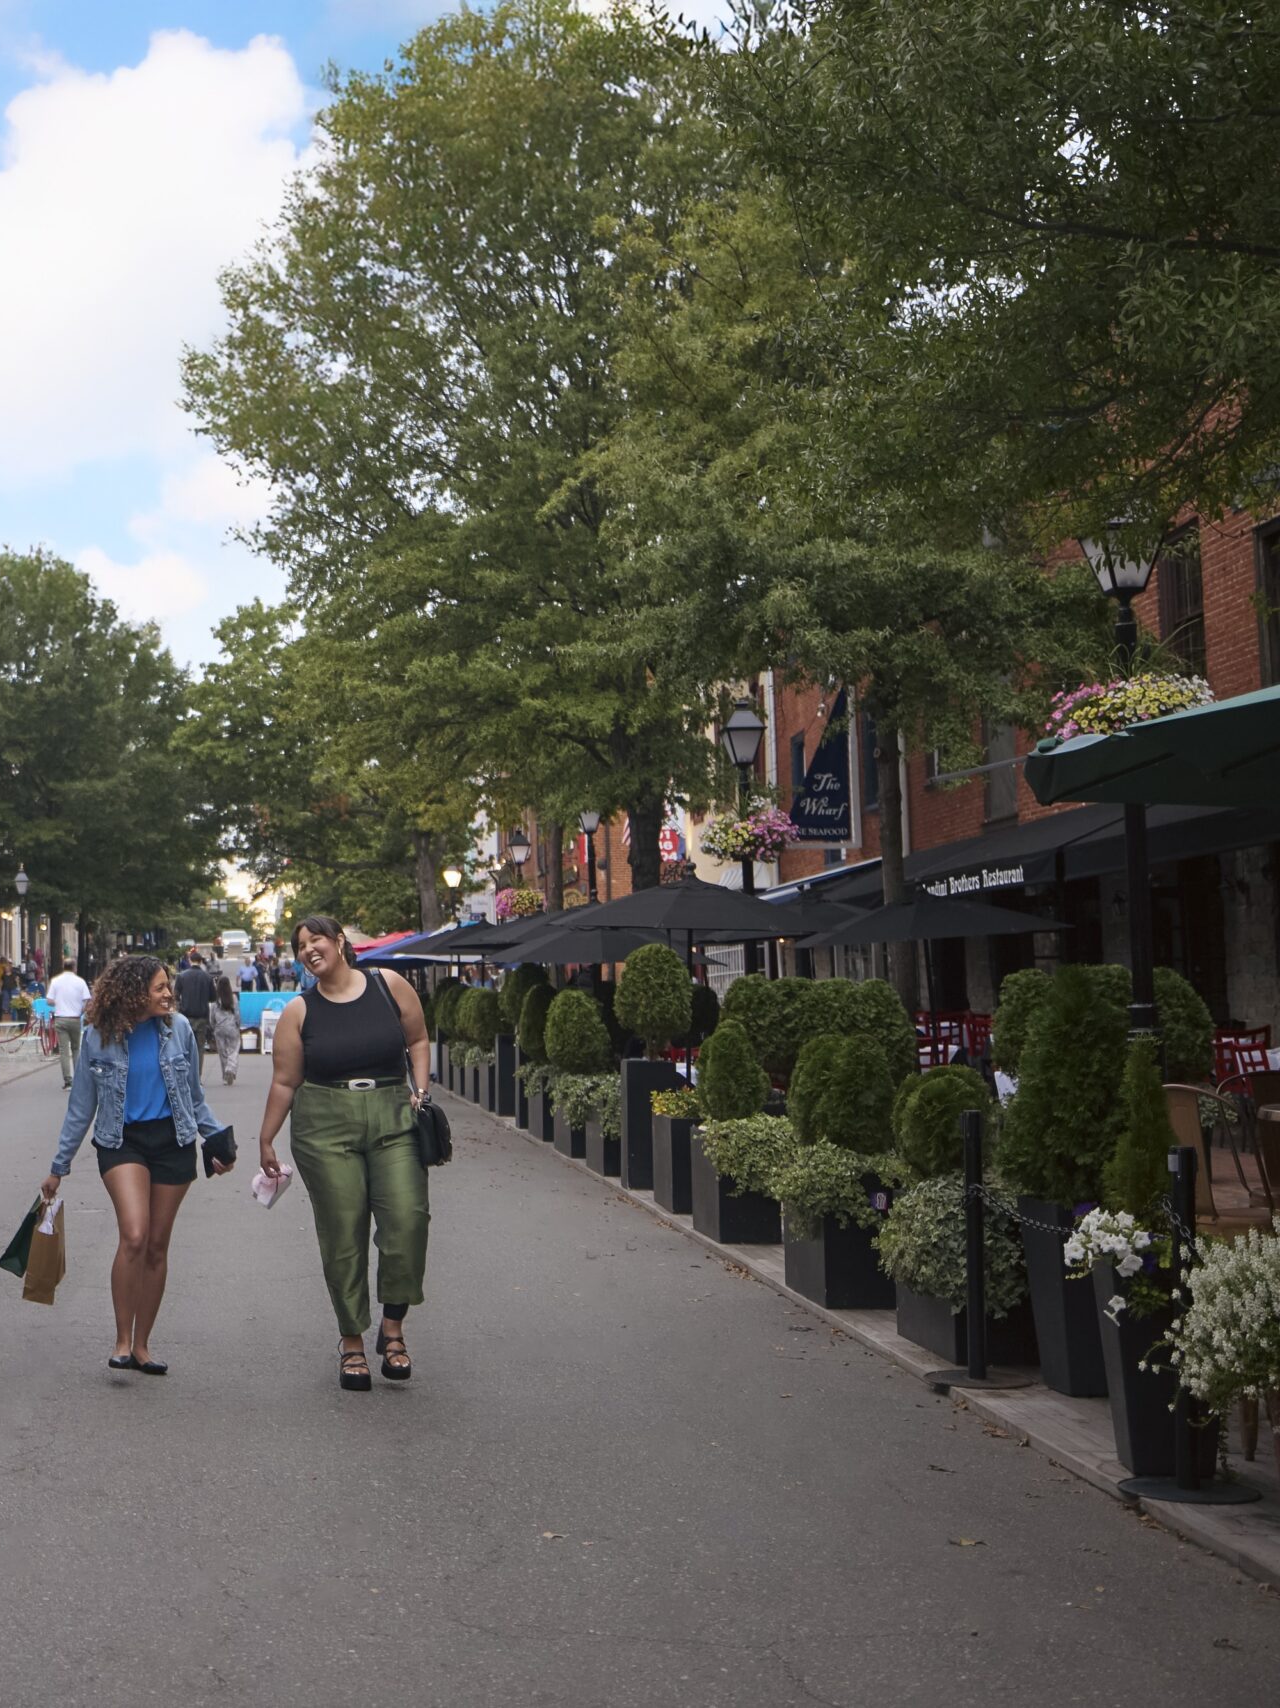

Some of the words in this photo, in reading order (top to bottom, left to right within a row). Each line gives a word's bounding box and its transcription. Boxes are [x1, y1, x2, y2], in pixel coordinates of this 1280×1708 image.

[812, 773, 840, 792] The
[800, 796, 848, 820] Wharf
[808, 827, 848, 836] SEAFOOD
[922, 879, 948, 896] andini
[949, 873, 980, 895] Brothers
[982, 864, 1024, 888] Restaurant
